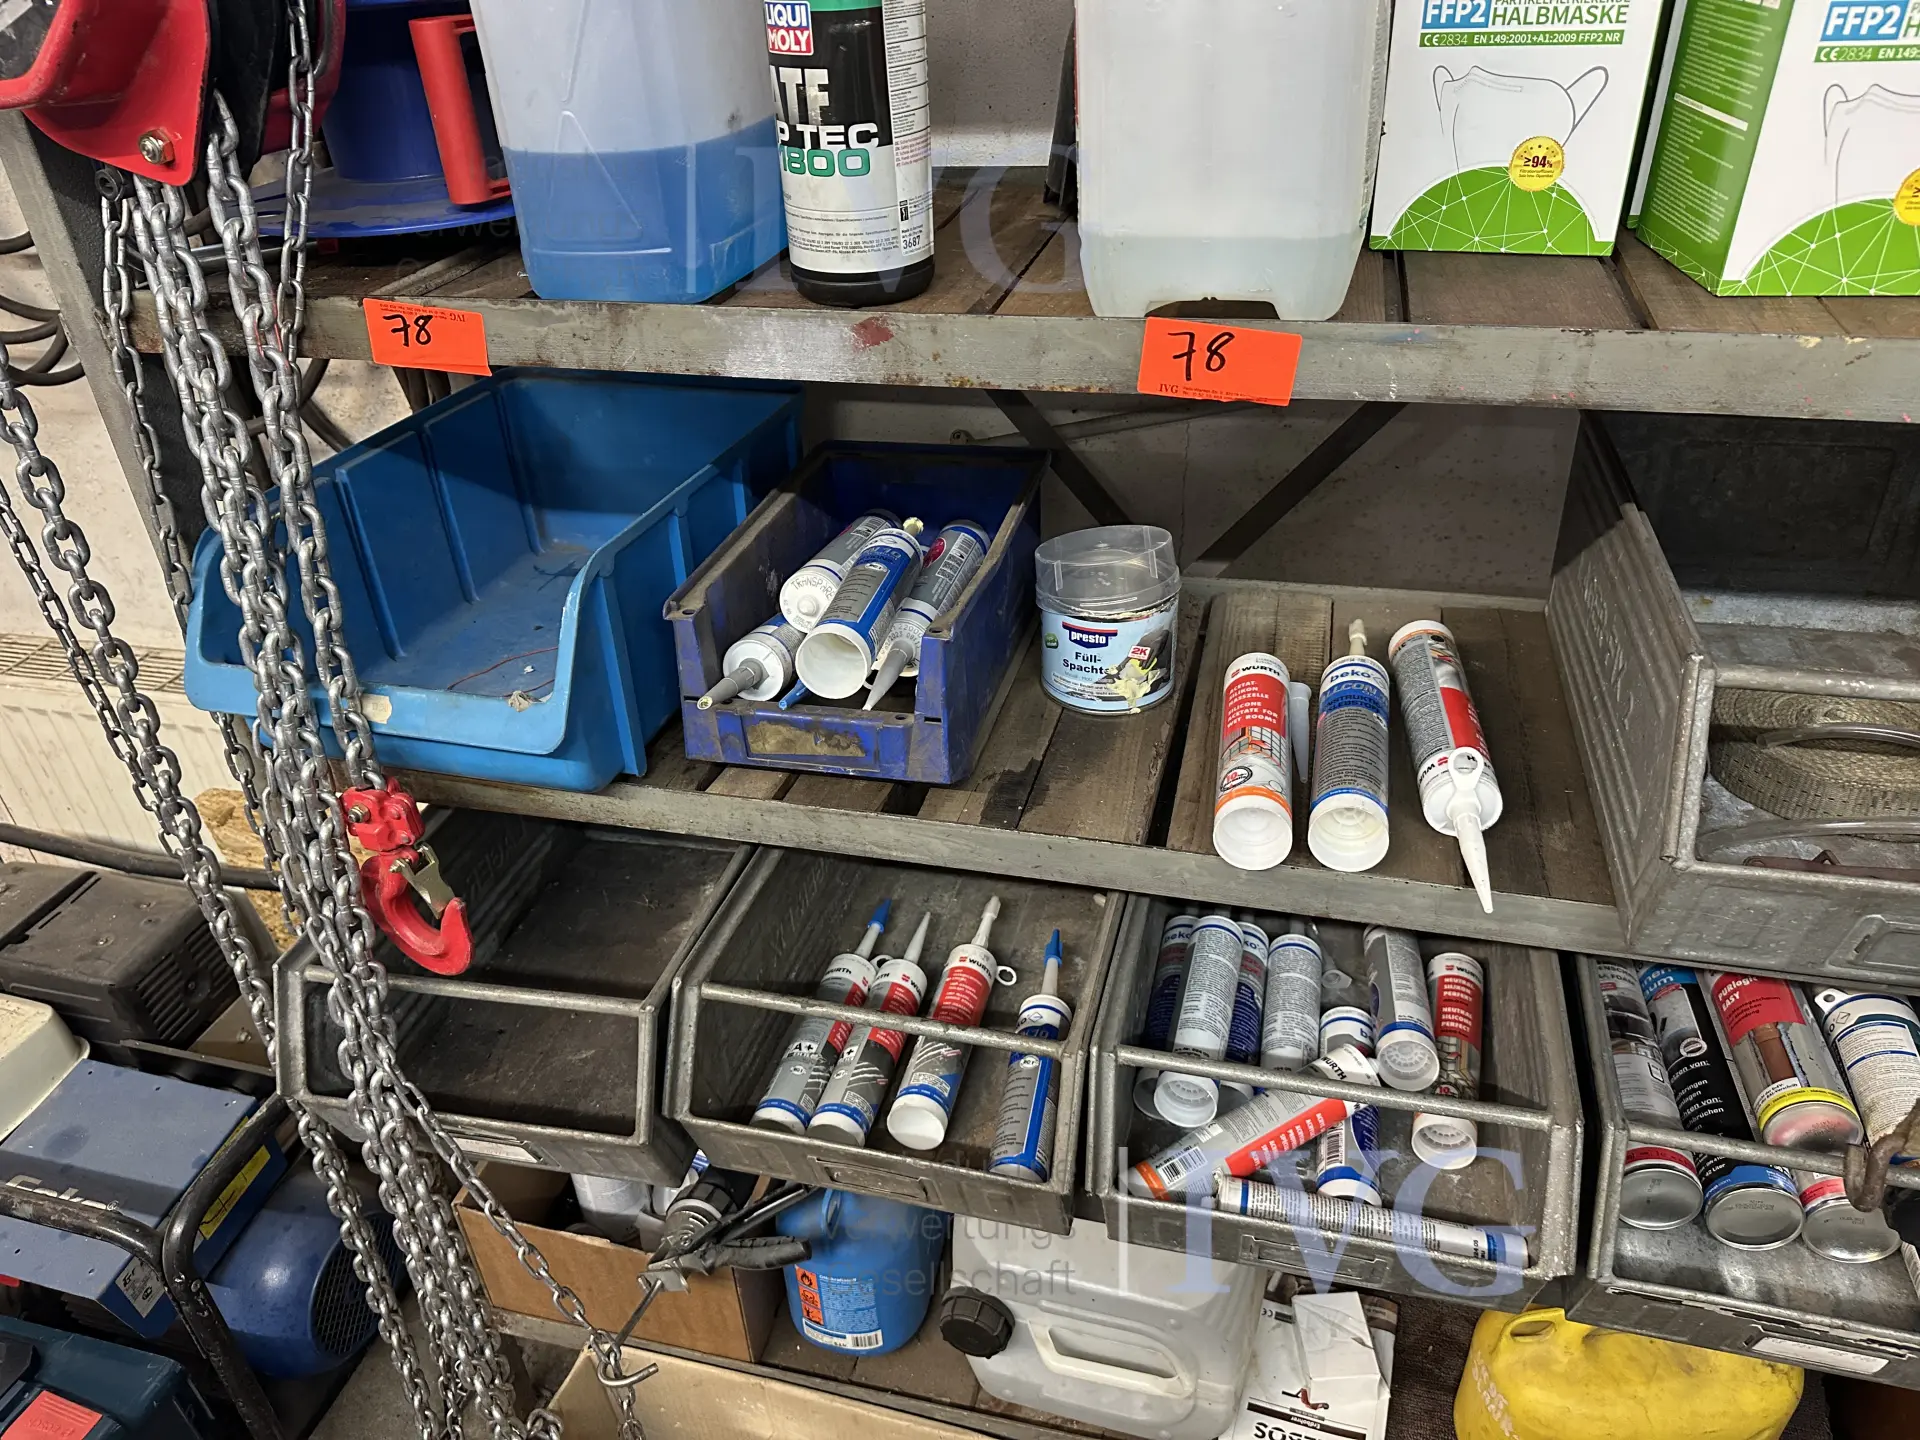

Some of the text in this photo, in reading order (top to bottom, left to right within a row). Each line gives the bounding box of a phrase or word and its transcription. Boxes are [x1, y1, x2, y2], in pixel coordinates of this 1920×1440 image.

[765, 3, 808, 28] LIQUI
[1426, 0, 1487, 25] FFP2
[1492, 4, 1630, 26] HALBMASKE
[1825, 5, 1901, 36] FFP2
[767, 27, 812, 53] MOLY
[1474, 34, 1487, 44] EN
[1578, 32, 1603, 43] FFP2
[1604, 32, 1621, 42] NR
[1878, 47, 1895, 59] EN
[796, 122, 879, 149] TEC
[778, 145, 872, 178] 1800
[902, 235, 921, 250] 3687
[382, 314, 433, 347] 78
[1168, 332, 1235, 381] 78
[1159, 384, 1179, 394] IVG
[1071, 631, 1106, 644] presto
[1075, 652, 1101, 663] Füll-
[1131, 648, 1148, 656] 2K
[1331, 669, 1371, 682] beko
[1229, 687, 1259, 701] SILIKON
[1228, 701, 1263, 716] SILICONE
[1228, 708, 1279, 723] ACETATE FOR
[1227, 714, 1277, 729] WET ROOMS
[1721, 991, 1741, 1012] EASY
[1441, 1021, 1471, 1034] PERFECT
[1689, 1060, 1711, 1071] von:
[1700, 1096, 1723, 1107] von:
[1712, 1163, 1726, 1173] Liter
[1291, 1416, 1321, 1430] Erdbohrer
